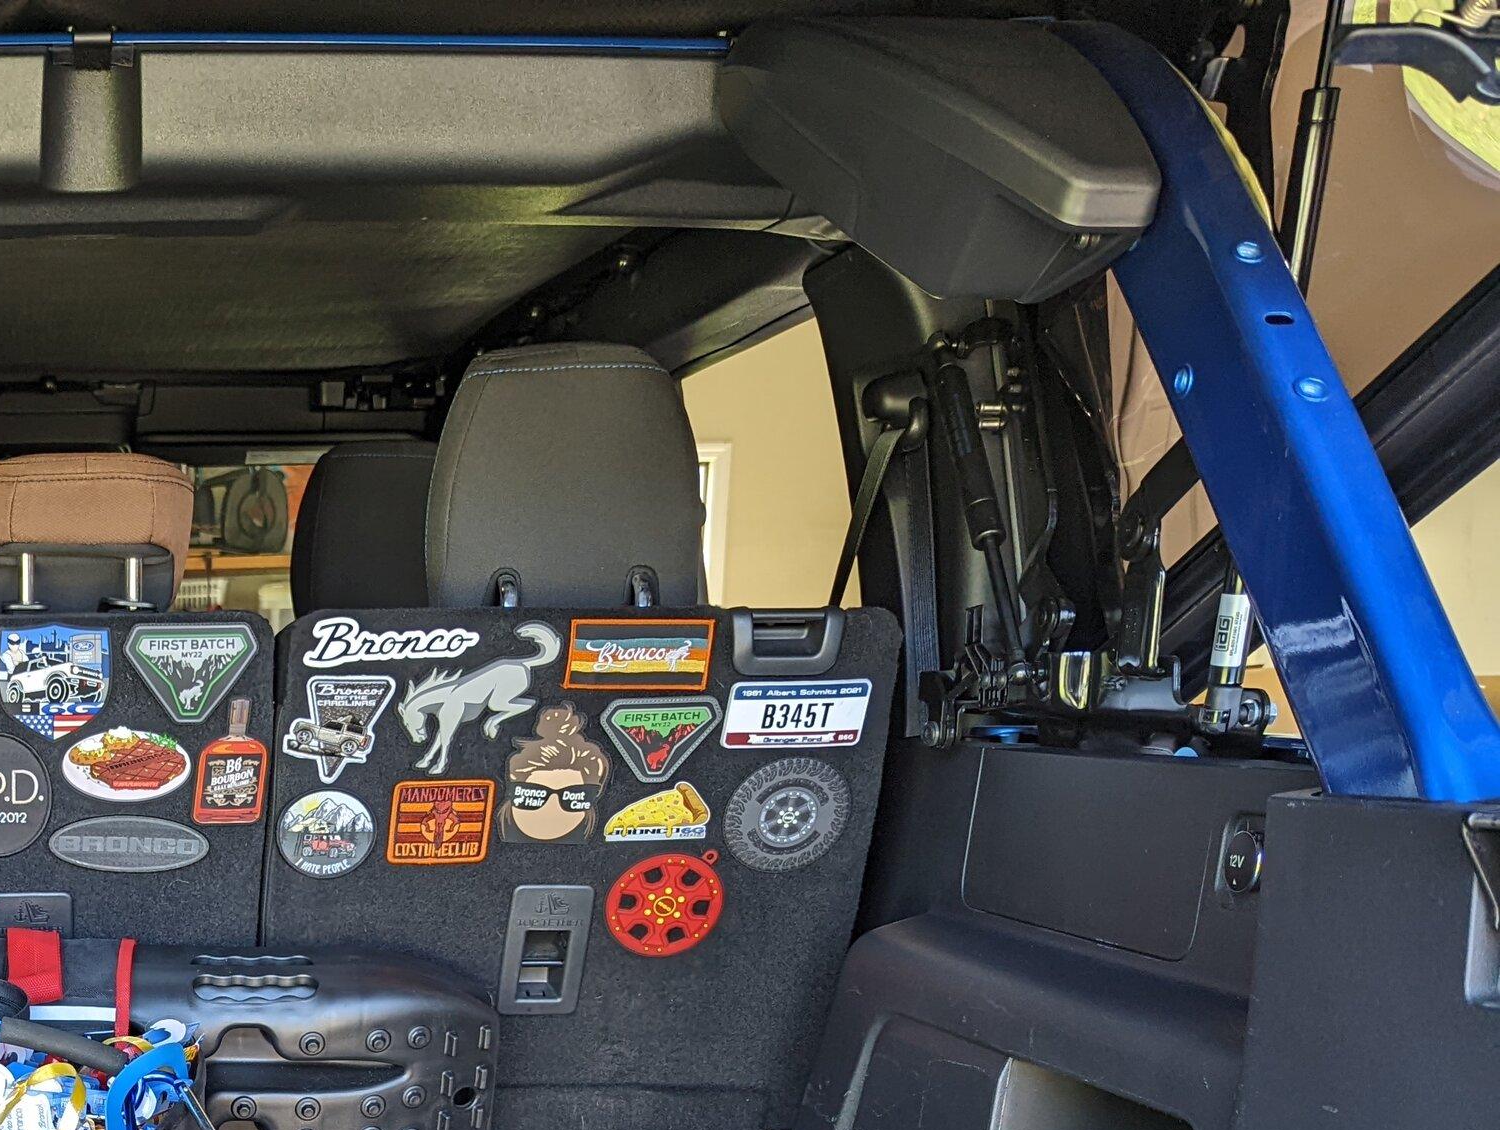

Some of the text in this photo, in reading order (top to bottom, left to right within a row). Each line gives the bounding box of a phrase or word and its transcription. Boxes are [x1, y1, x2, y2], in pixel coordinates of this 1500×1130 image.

[149, 638, 235, 650] FIRST BATCH
[308, 622, 474, 662] Bronco
[586, 641, 668, 672] Bronco
[316, 684, 385, 696] Broncos
[766, 688, 797, 696] Albert
[624, 711, 701, 722] FIRST BATCH
[761, 702, 834, 729] B345T
[211, 768, 254, 786] BOURBON
[514, 786, 547, 797] Bronco
[562, 791, 586, 801] Dont
[525, 798, 545, 807] Hair
[570, 801, 591, 809] Care
[58, 835, 200, 855] BRONCO
[294, 857, 351, 875] I HATE PEOPLE
[1229, 854, 1245, 868] 12V
